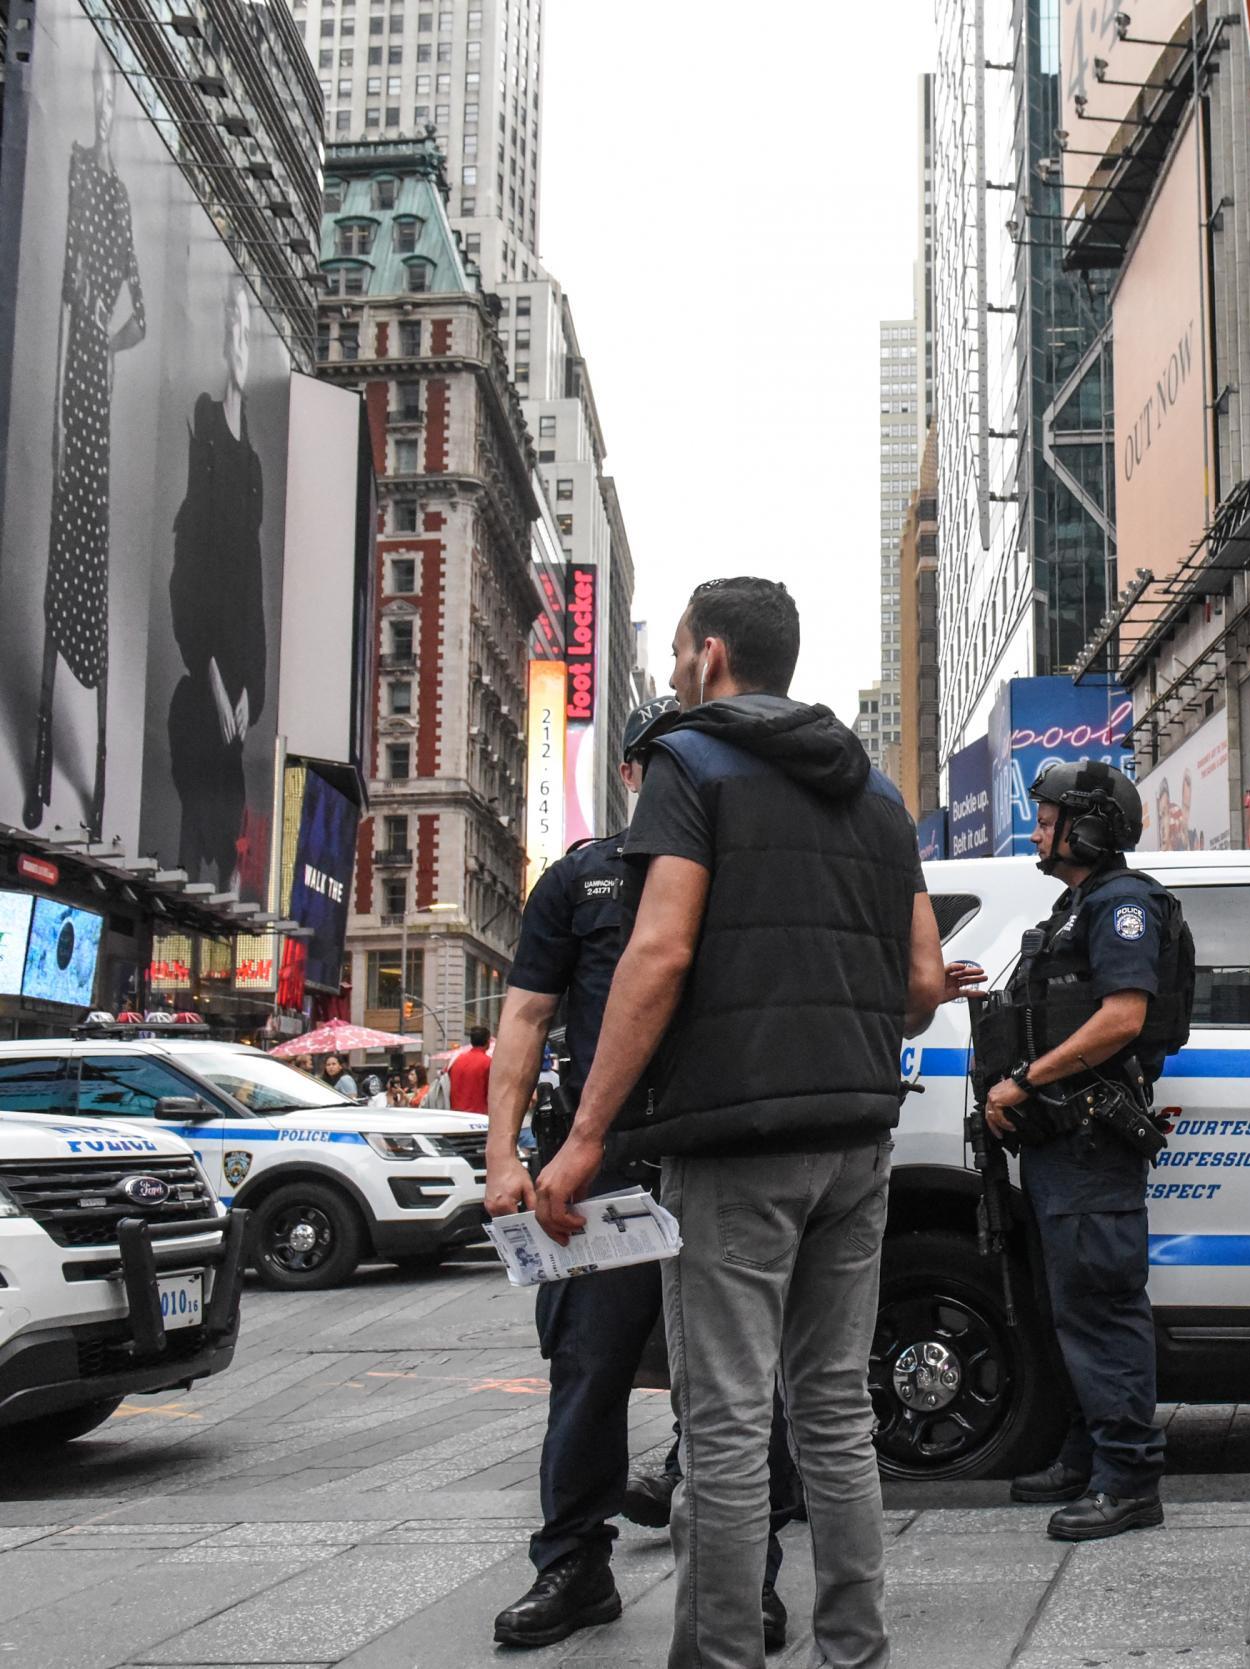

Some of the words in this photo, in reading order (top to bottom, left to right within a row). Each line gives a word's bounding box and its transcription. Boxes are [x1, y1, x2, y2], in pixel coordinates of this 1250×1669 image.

[1125, 396, 1152, 482] OUT
[1156, 319, 1194, 430] NOW
[567, 569, 593, 655] Locker
[567, 662, 592, 718] Foot
[637, 698, 681, 725] NY
[953, 792, 976, 822] Buckle
[978, 789, 990, 812] up.
[953, 832, 966, 857] Belt
[967, 829, 973, 850] it
[974, 824, 989, 846] out.
[304, 864, 328, 894] WALK
[328, 877, 344, 903] THE
[280, 1130, 331, 1143] POLICE
[139, 1181, 164, 1198] Ford
[1145, 1184, 1221, 1199] ESPECT
